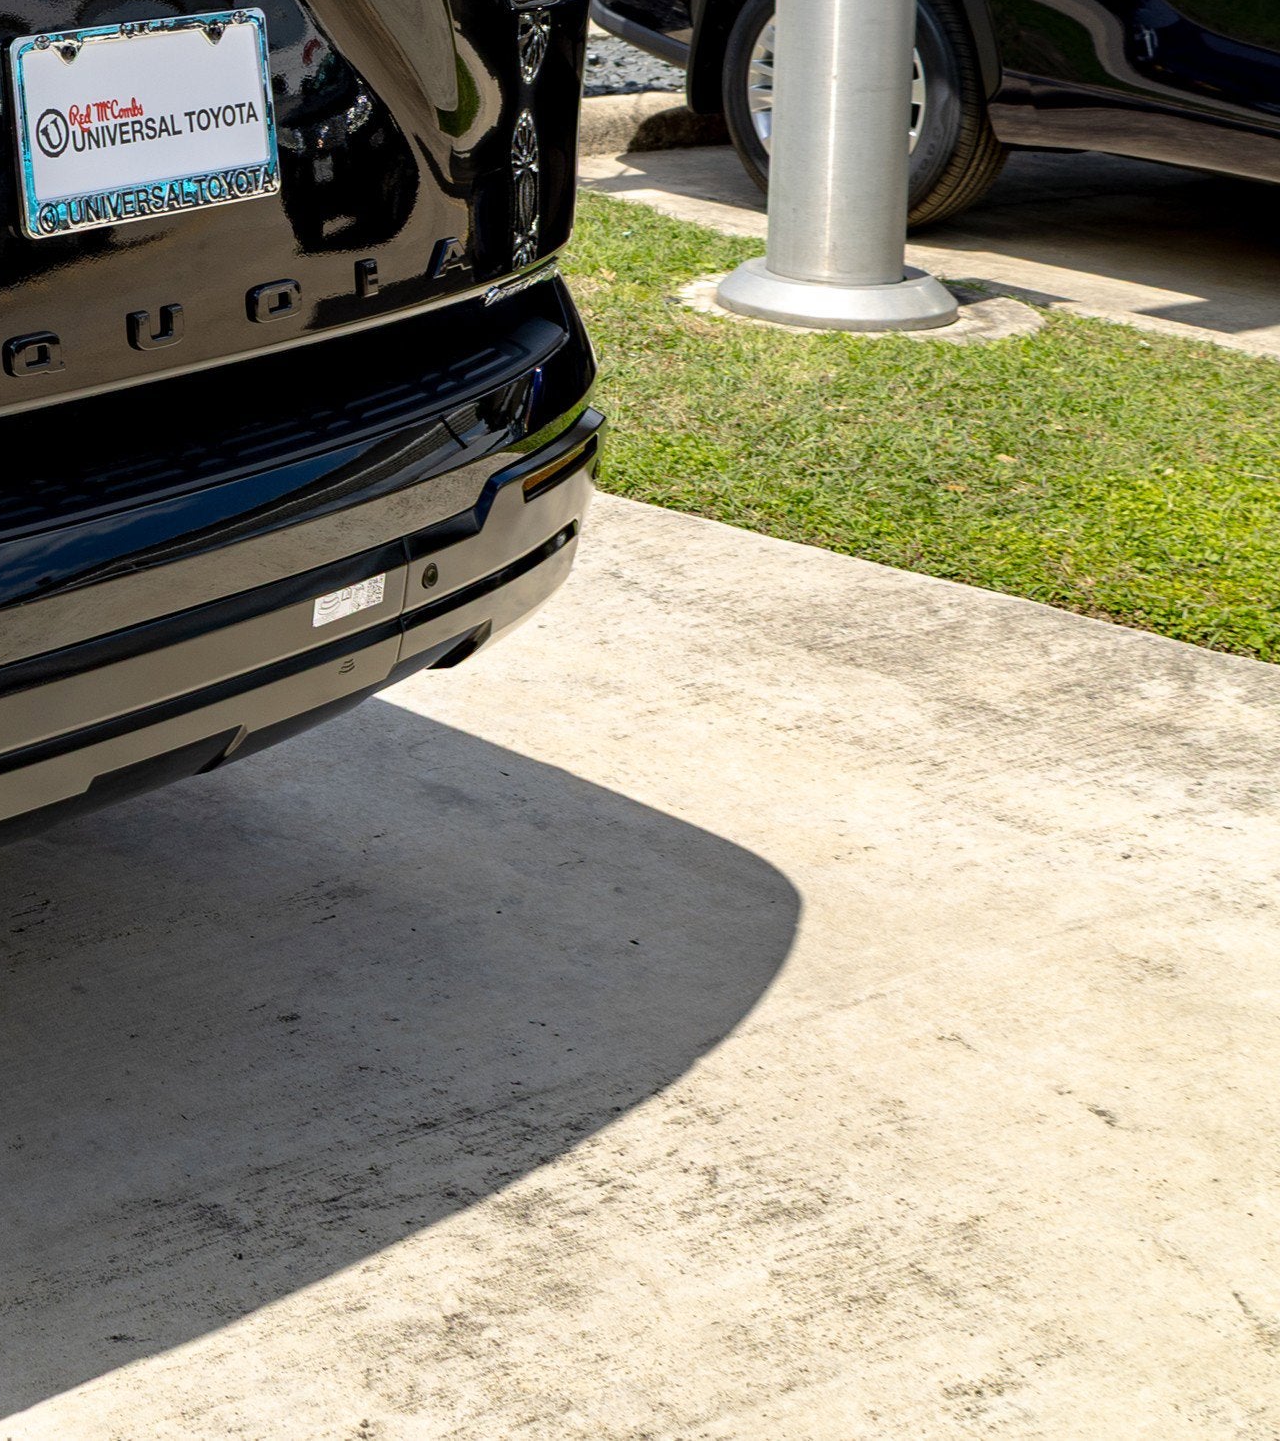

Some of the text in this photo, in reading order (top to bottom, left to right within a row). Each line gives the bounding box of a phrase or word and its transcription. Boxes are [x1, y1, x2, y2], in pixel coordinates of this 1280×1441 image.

[69, 97, 143, 132] Red McCombs
[72, 102, 259, 153] UNIVERSAL TOYOTA
[67, 166, 274, 226] UNIVERSAL TOYOTA
